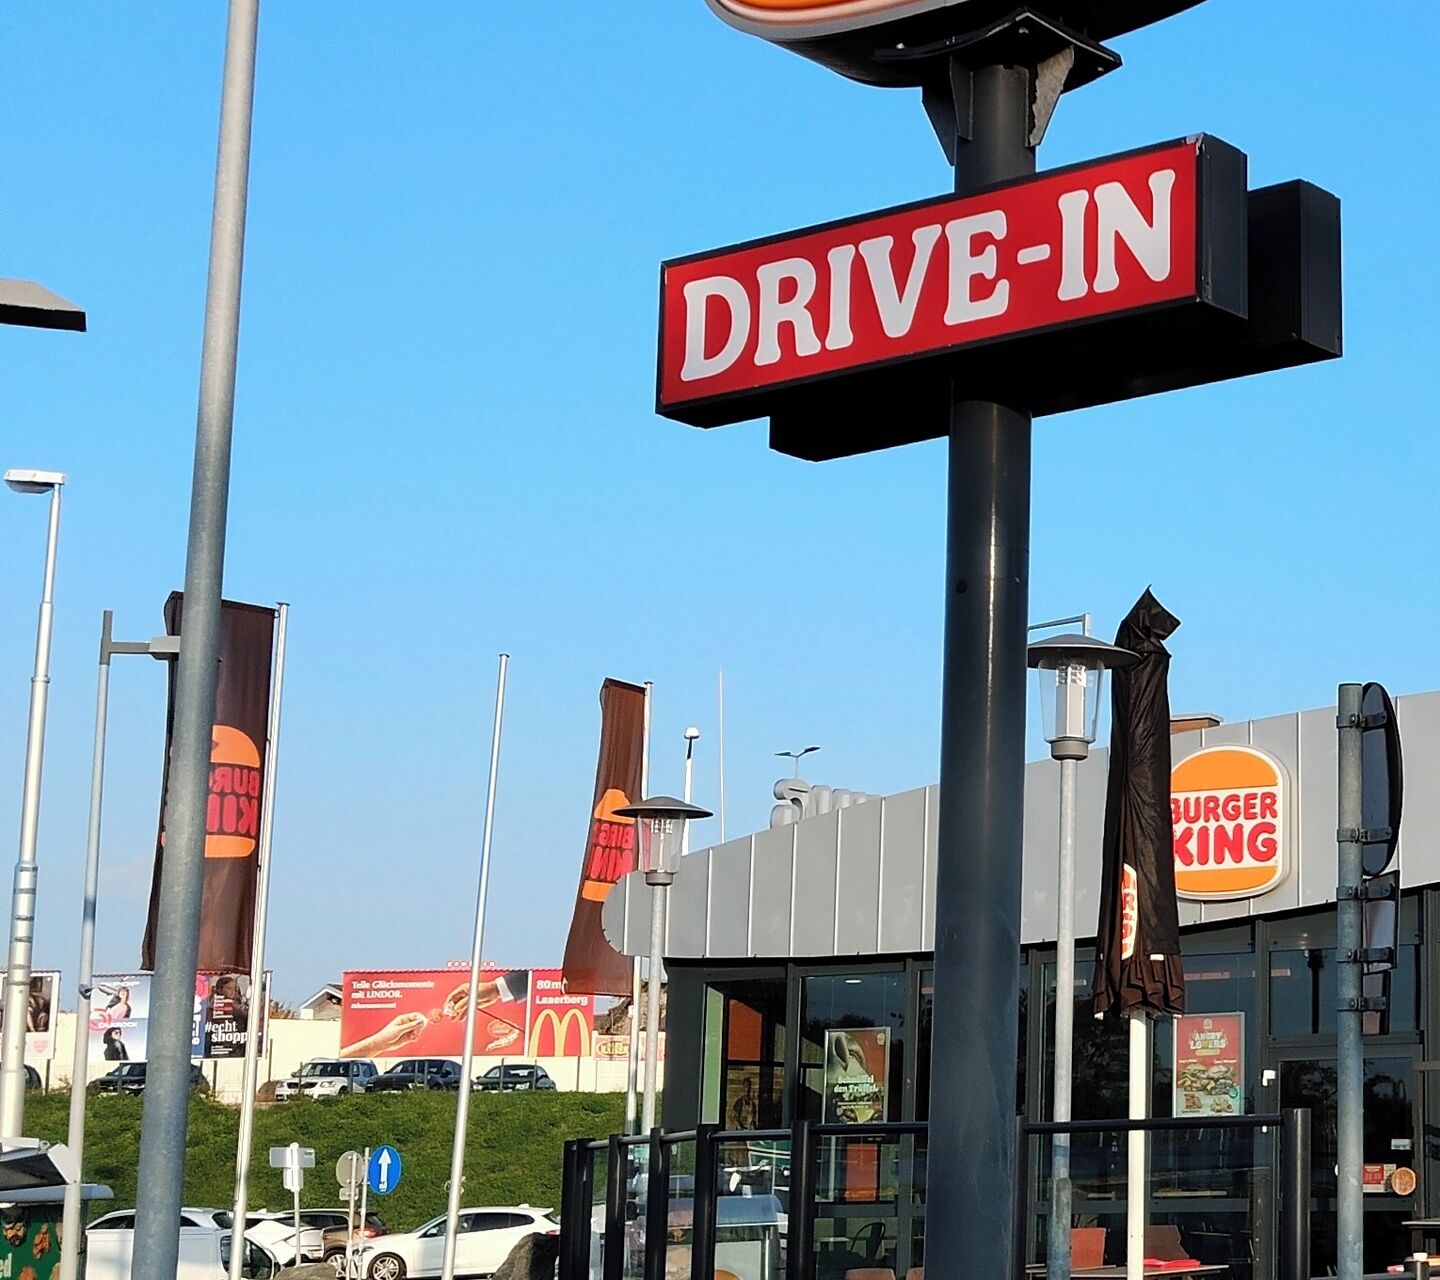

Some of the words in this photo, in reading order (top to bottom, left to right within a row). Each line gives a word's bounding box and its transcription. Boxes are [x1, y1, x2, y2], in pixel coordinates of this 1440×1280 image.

[680, 168, 1176, 382] DRIVE-IN
[1172, 821, 1278, 867] KING
[204, 1019, 238, 1033] #echt
